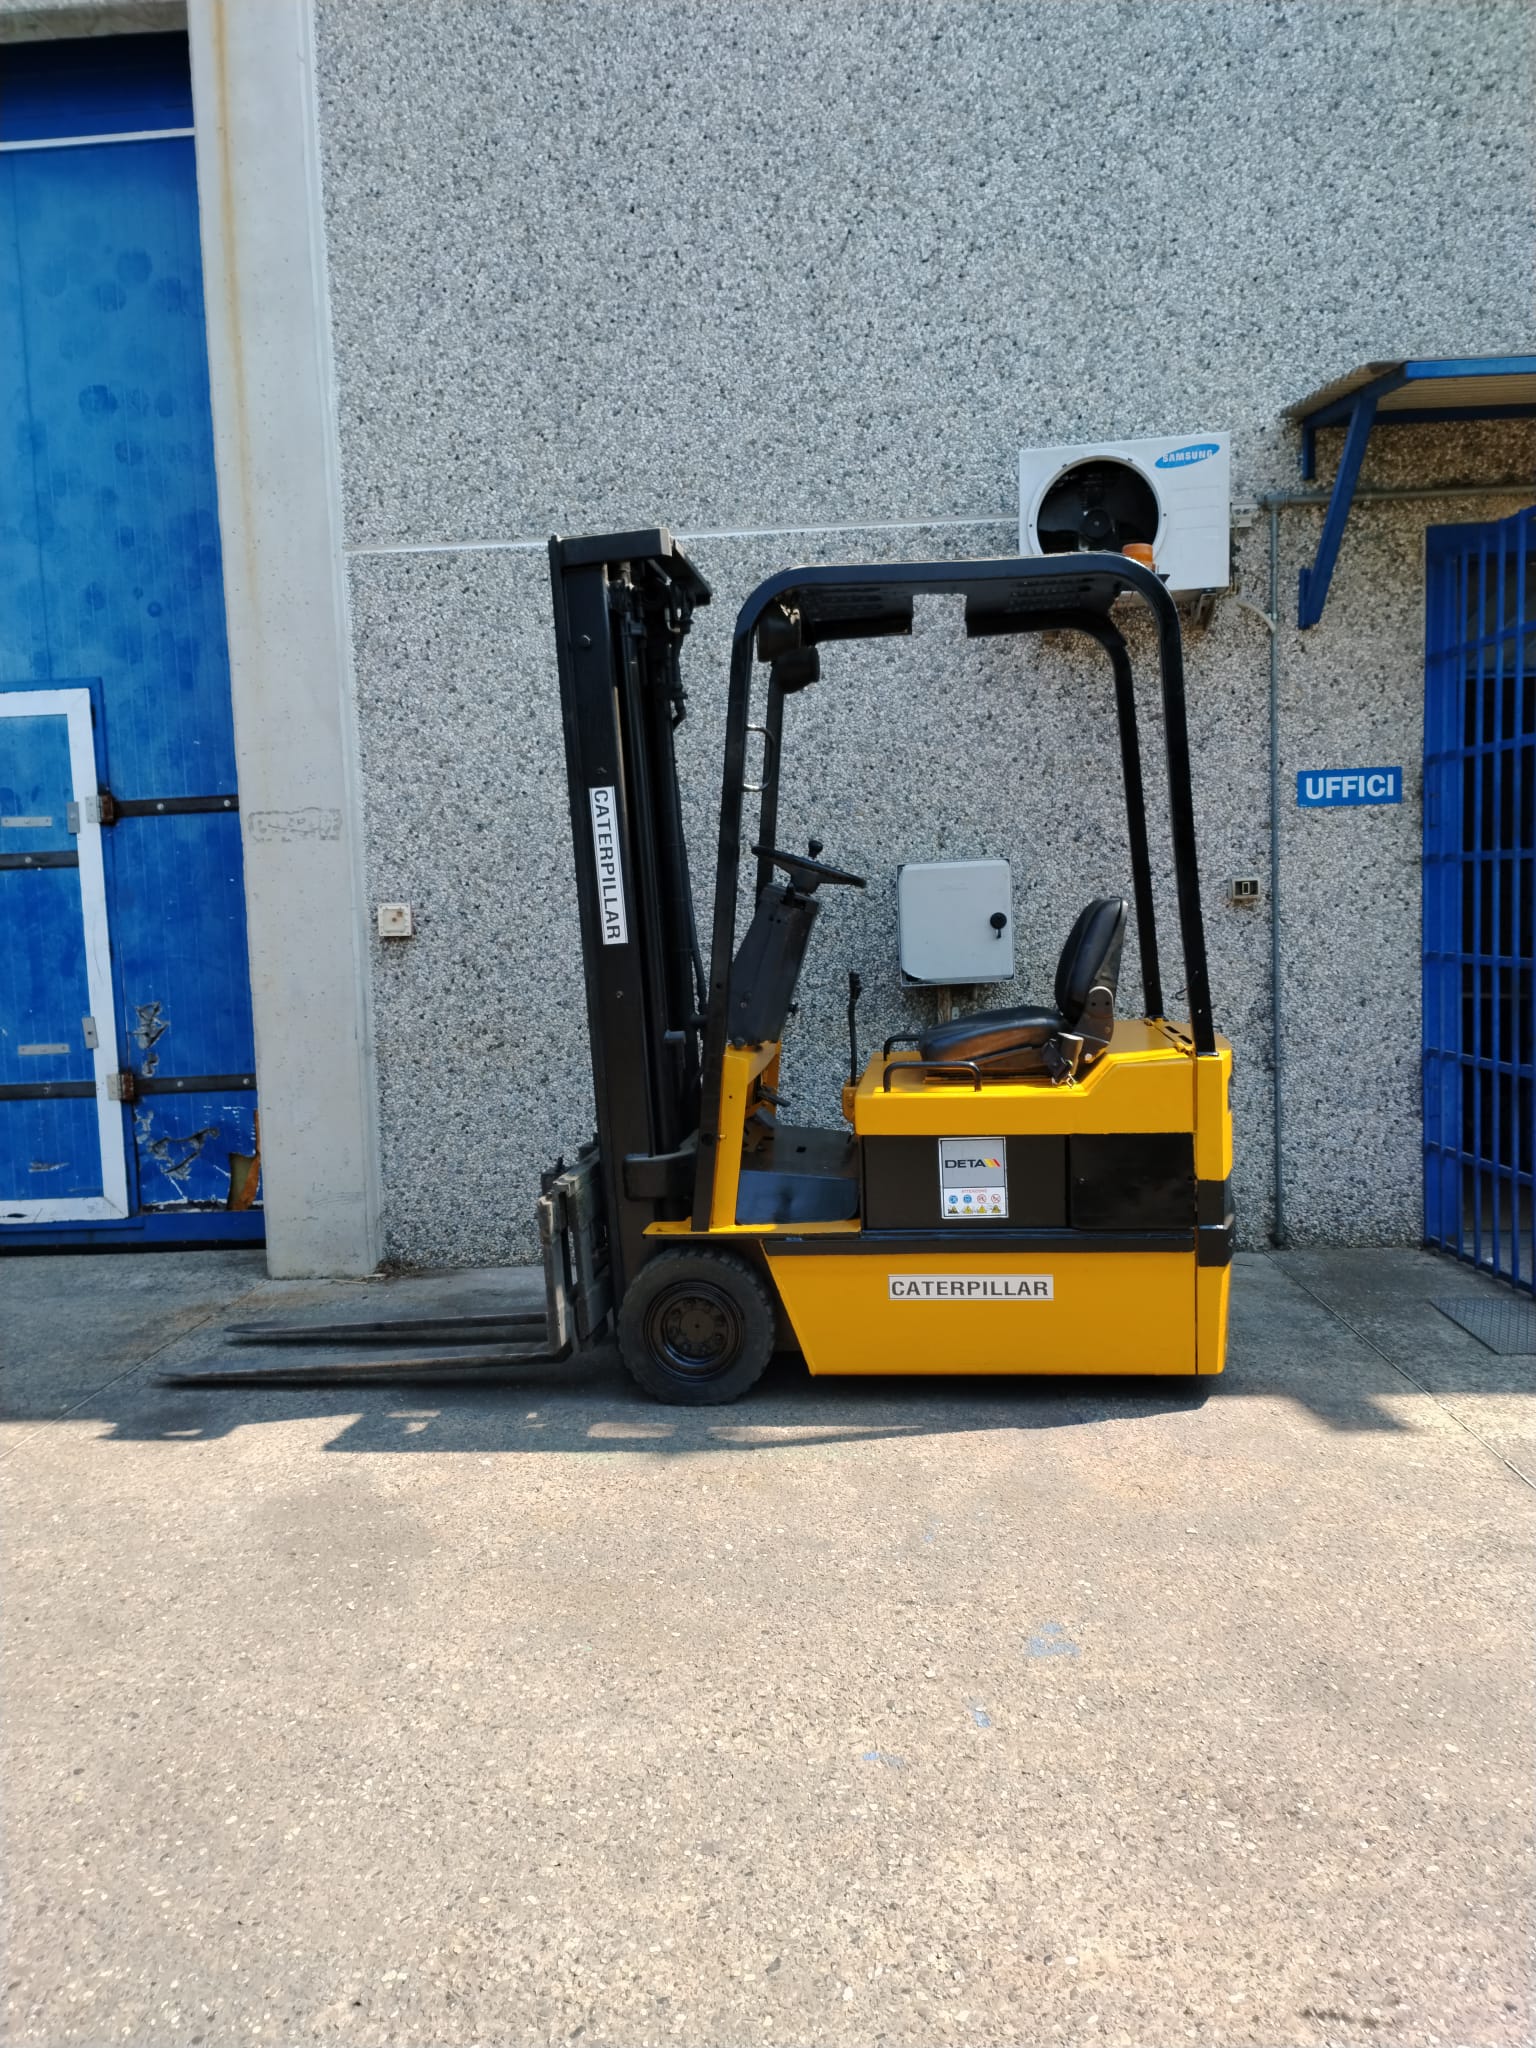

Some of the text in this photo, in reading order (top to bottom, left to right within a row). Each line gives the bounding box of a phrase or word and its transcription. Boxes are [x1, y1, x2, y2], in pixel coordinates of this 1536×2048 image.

[1162, 449, 1213, 463] SAMSUNG
[1306, 774, 1394, 800] UFFICI
[594, 790, 621, 939] CATERPILLAR
[944, 1159, 986, 1169] DETA
[891, 1281, 1049, 1296] CATERPILLAR
